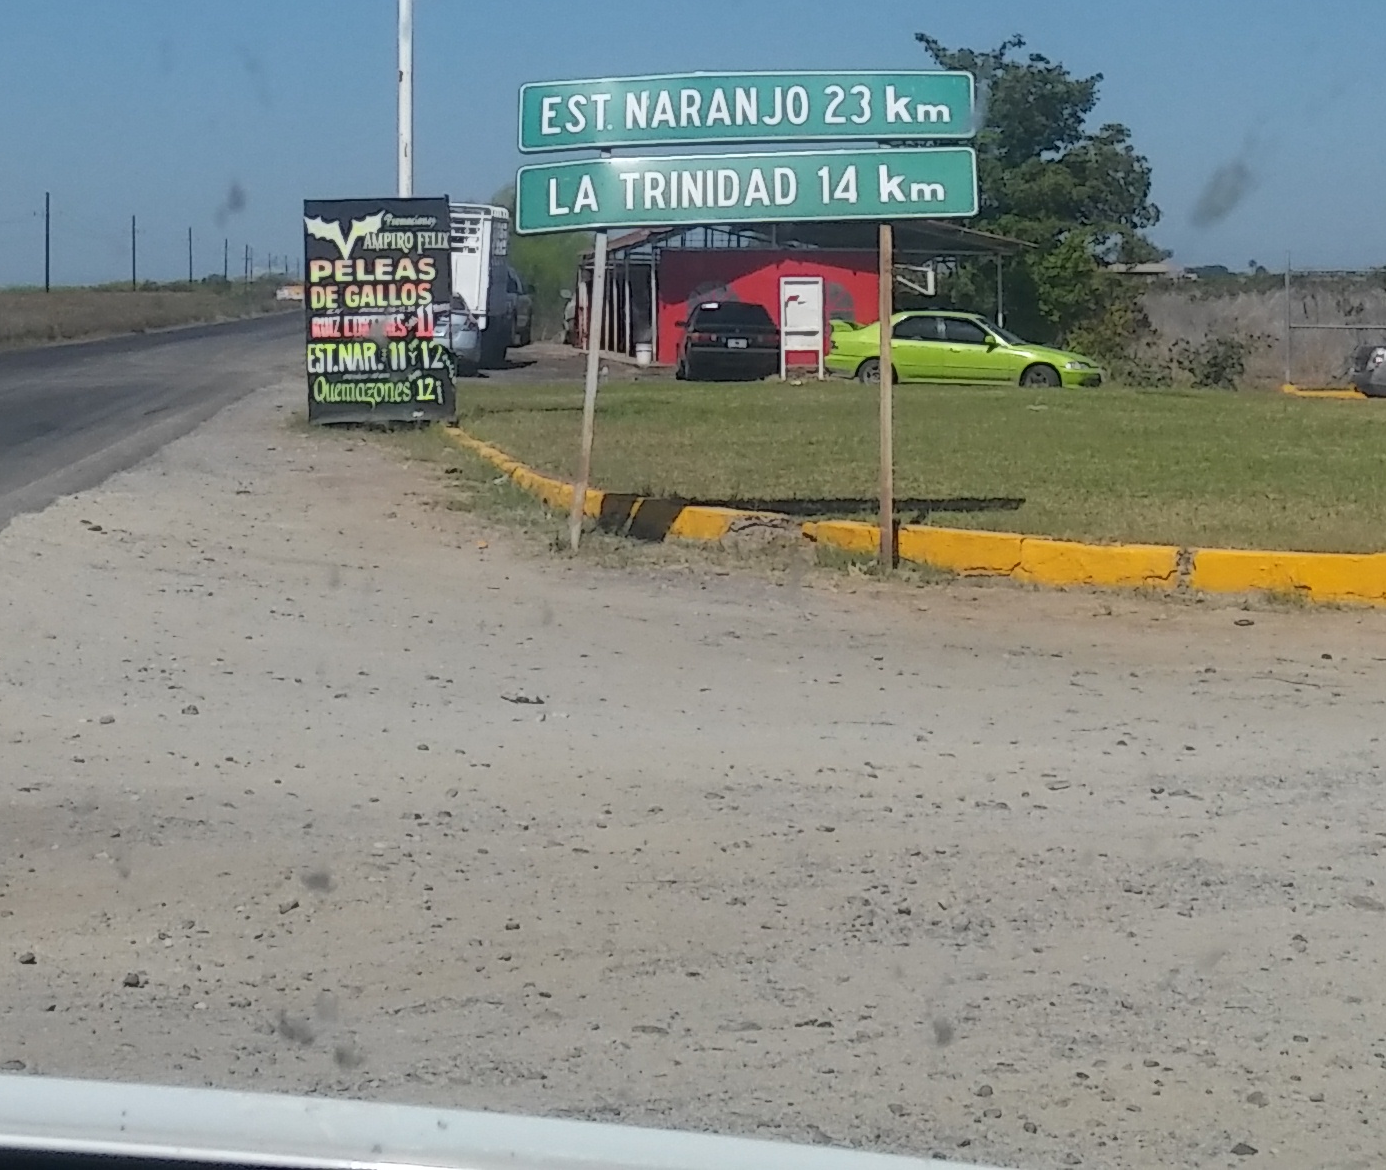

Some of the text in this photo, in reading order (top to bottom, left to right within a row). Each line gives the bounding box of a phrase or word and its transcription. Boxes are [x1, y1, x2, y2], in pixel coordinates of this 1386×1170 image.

[541, 85, 951, 135] EST. NARANJO 23 km
[548, 164, 946, 216] LA TRINIDAD 14 km
[416, 232, 450, 255] FELIX
[310, 258, 437, 282] PELEAS
[310, 283, 433, 309] DE GALLOS
[389, 341, 406, 370] 11
[421, 341, 444, 368] 12
[313, 376, 412, 409] Quemazones
[417, 377, 435, 400] 12
